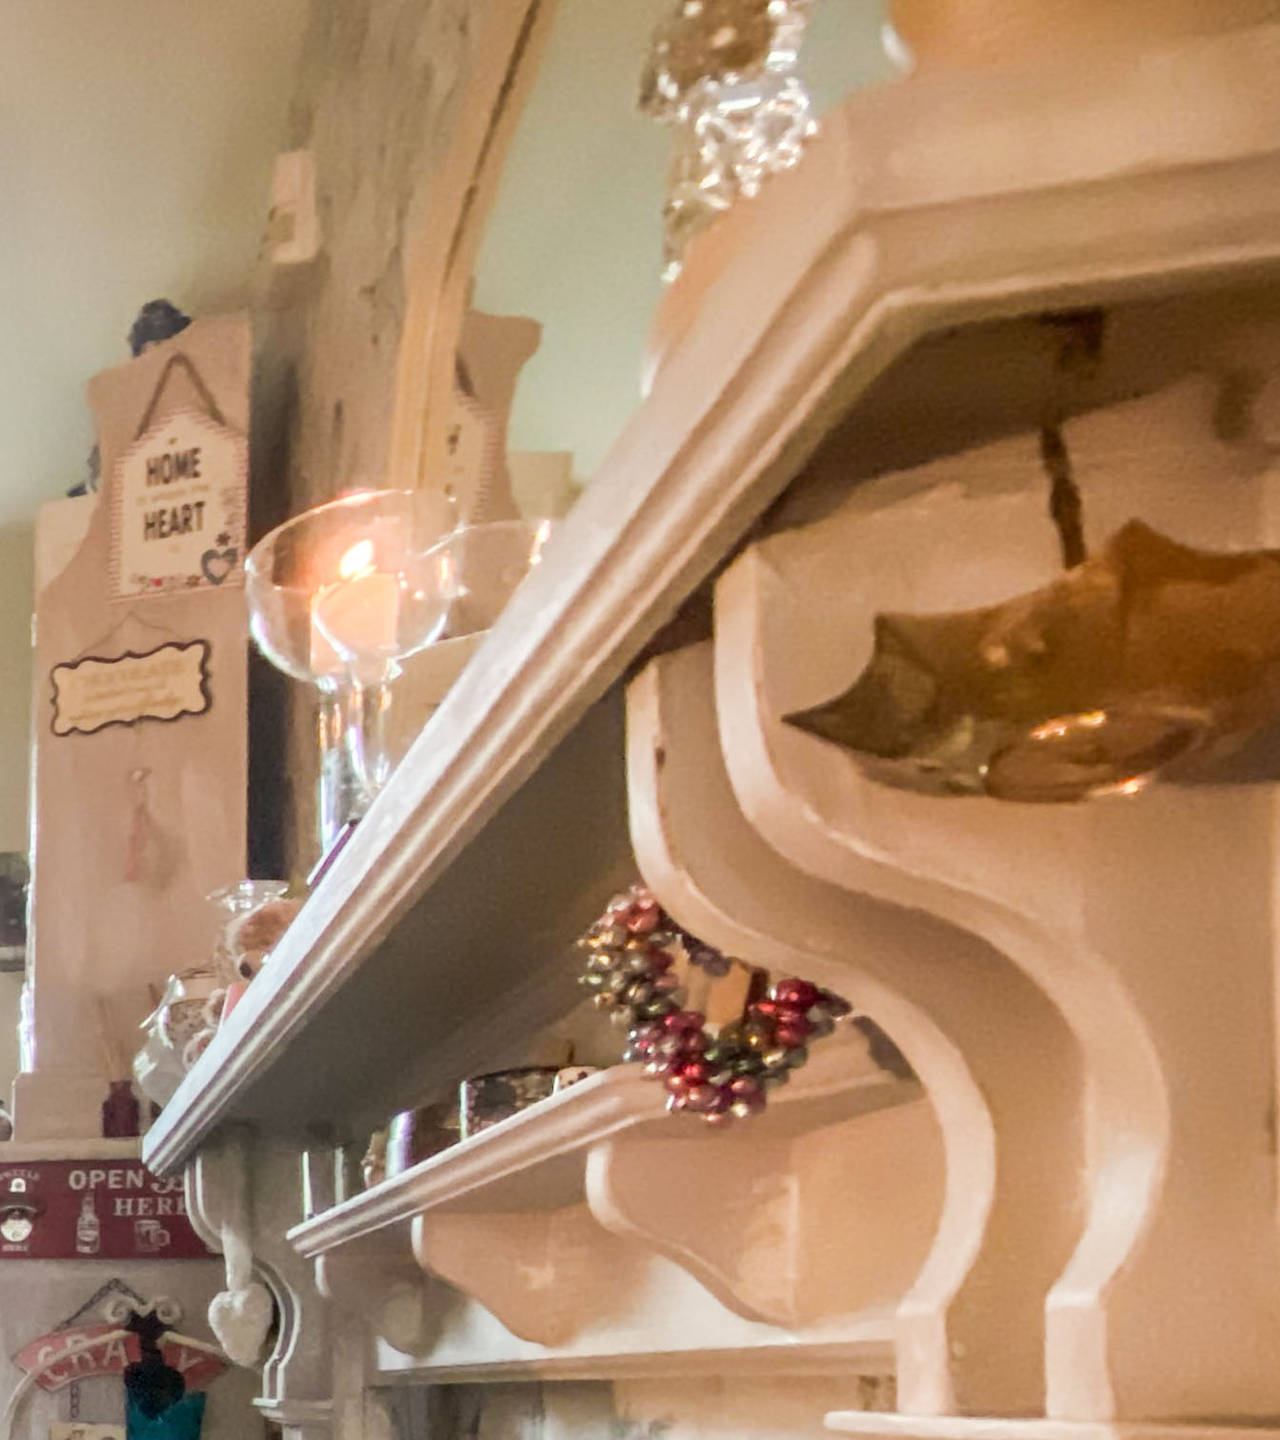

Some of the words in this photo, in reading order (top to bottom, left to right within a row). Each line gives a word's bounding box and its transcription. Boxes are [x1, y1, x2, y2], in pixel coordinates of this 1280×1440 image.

[146, 448, 201, 486] HOME
[144, 501, 205, 541] HEART
[68, 1169, 145, 1191] OPEN
